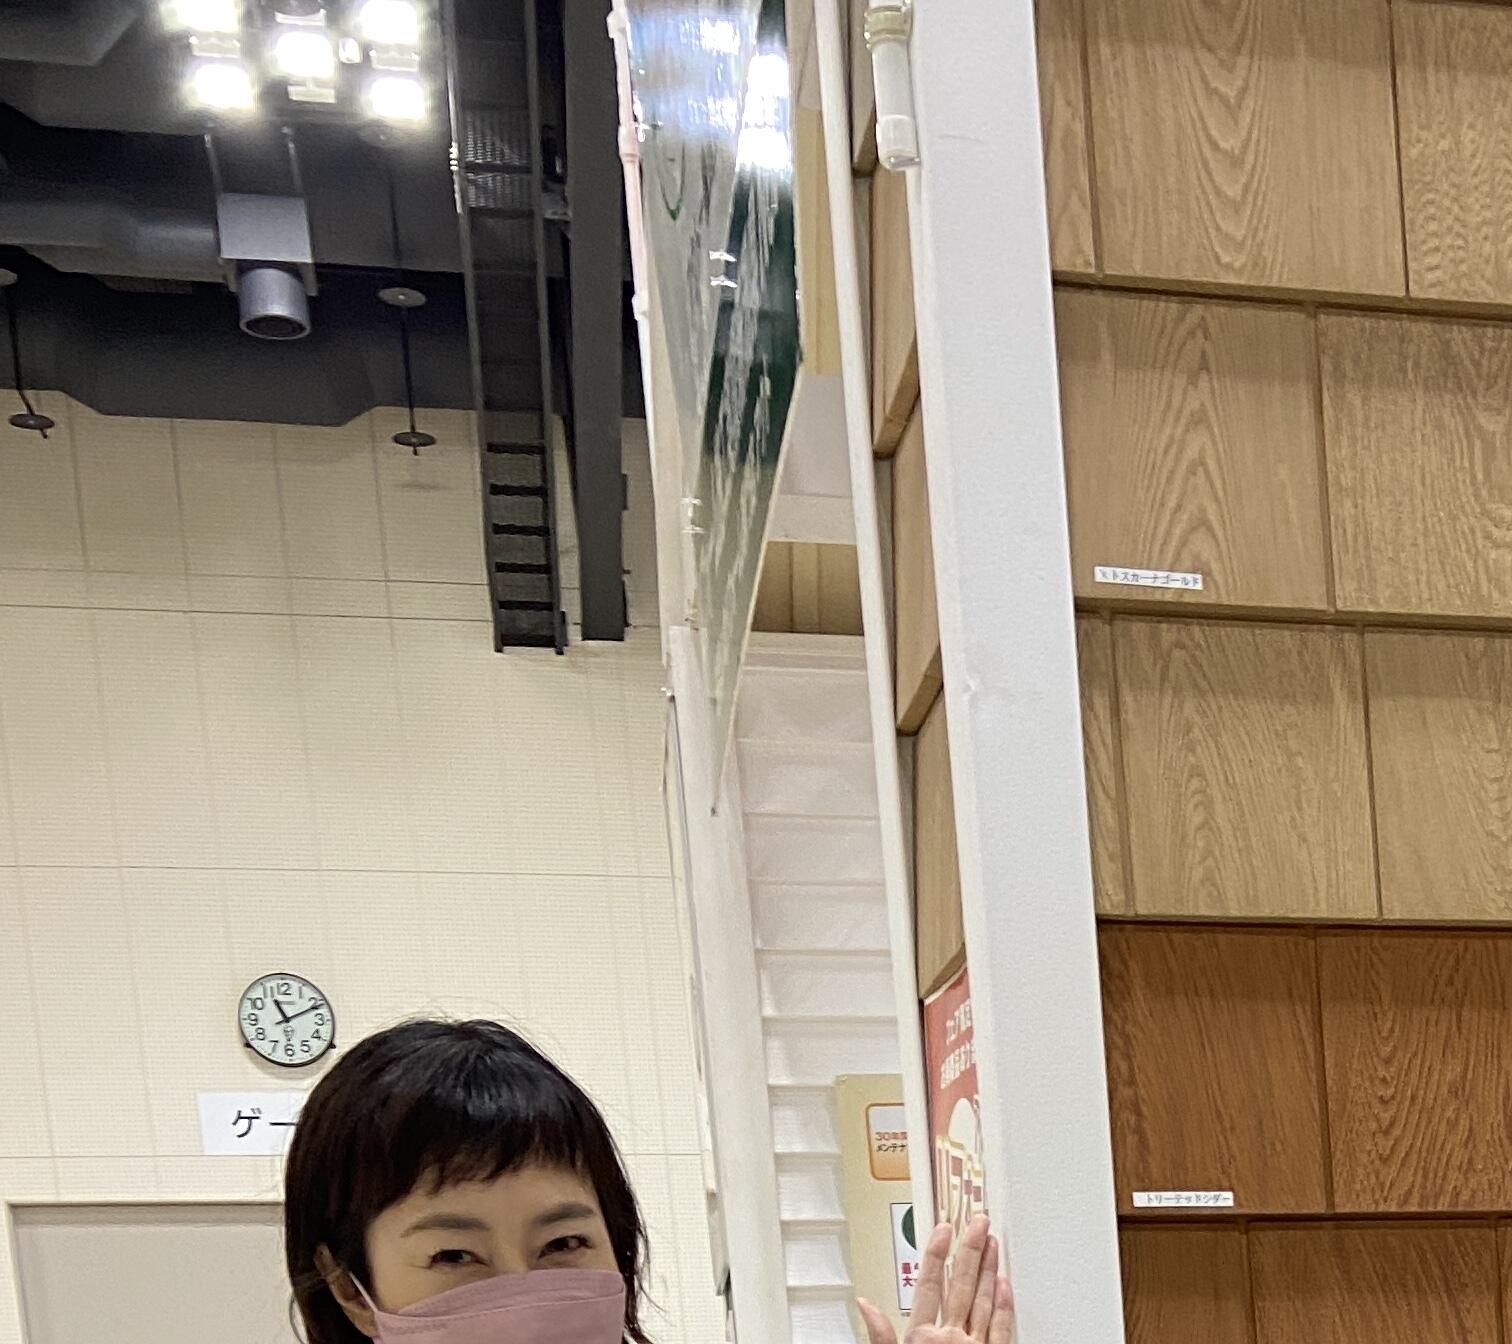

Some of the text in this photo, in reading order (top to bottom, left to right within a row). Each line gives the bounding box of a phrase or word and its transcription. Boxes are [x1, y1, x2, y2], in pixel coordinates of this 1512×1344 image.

[277, 982, 292, 996] 12
[247, 1012, 258, 1026] 9
[314, 1012, 325, 1026] 3
[255, 1027, 265, 1040] 8
[310, 1028, 323, 1040] 4
[268, 1040, 279, 1055] 7
[284, 1043, 295, 1057] 6
[300, 1040, 311, 1053] 5
